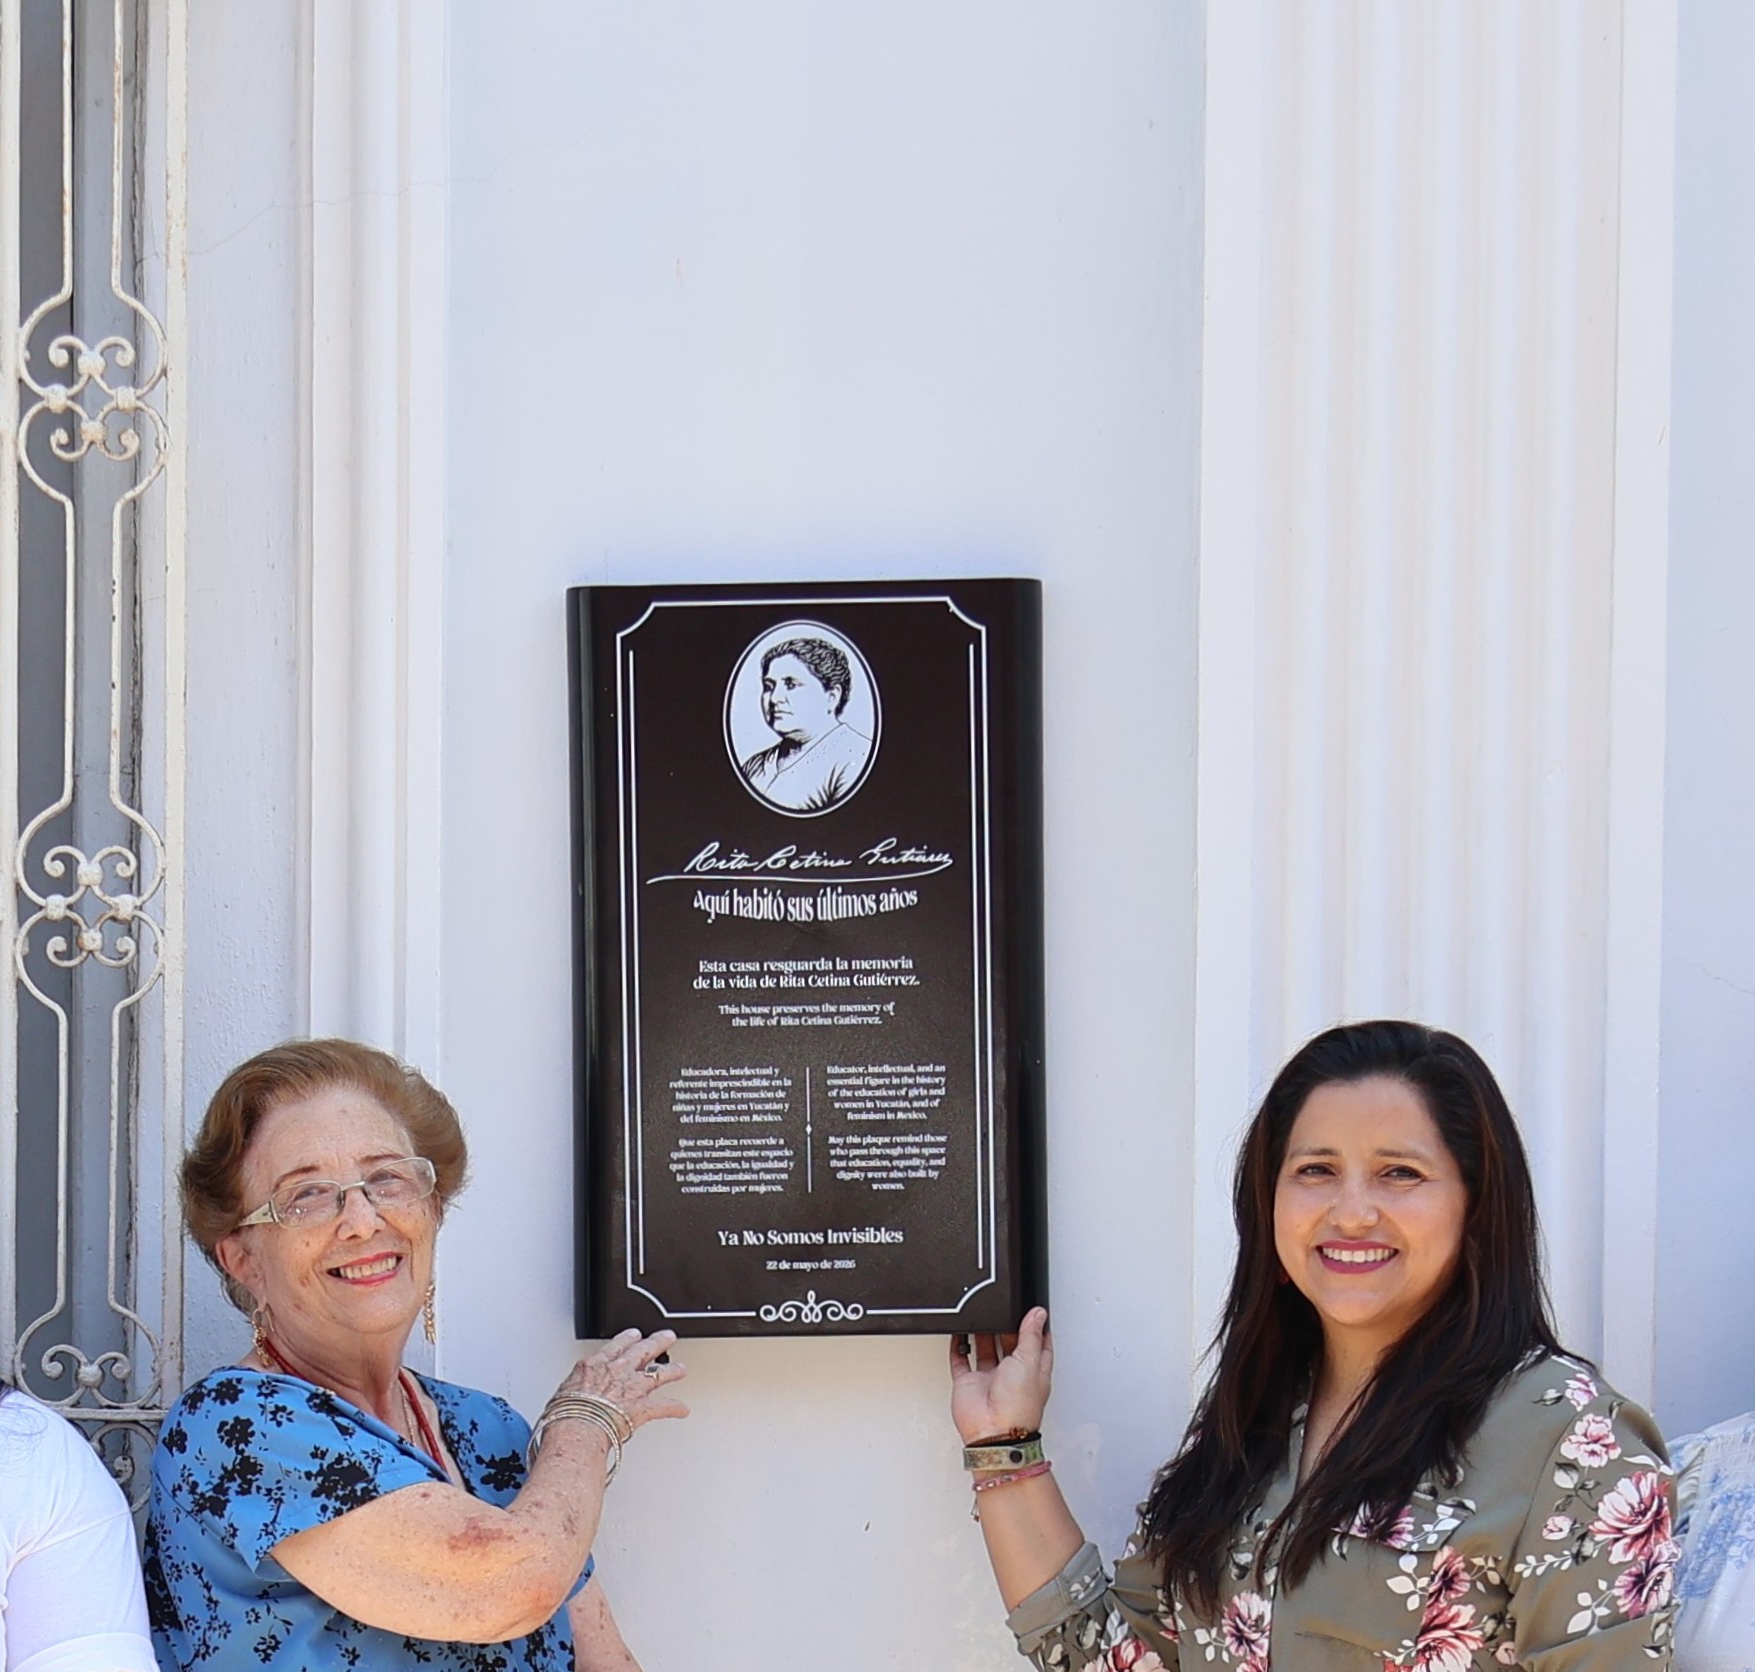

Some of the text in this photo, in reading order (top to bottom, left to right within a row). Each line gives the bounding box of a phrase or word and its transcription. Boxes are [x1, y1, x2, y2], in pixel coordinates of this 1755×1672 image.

[694, 885, 918, 924] Aquí habitó sus últimos años
[699, 956, 913, 974] Esta casa resguarda la memoria
[693, 973, 920, 989] de la vida de Rita Cetina Gutiérrez.
[718, 1002, 895, 1016] This house preserves the memory of
[732, 1015, 883, 1026] the life of Rita Cetina Gutiérrez.
[718, 1227, 904, 1245] Ya No Somos Invisibles
[766, 1259, 856, 1272] 22 de mayo de 2026
